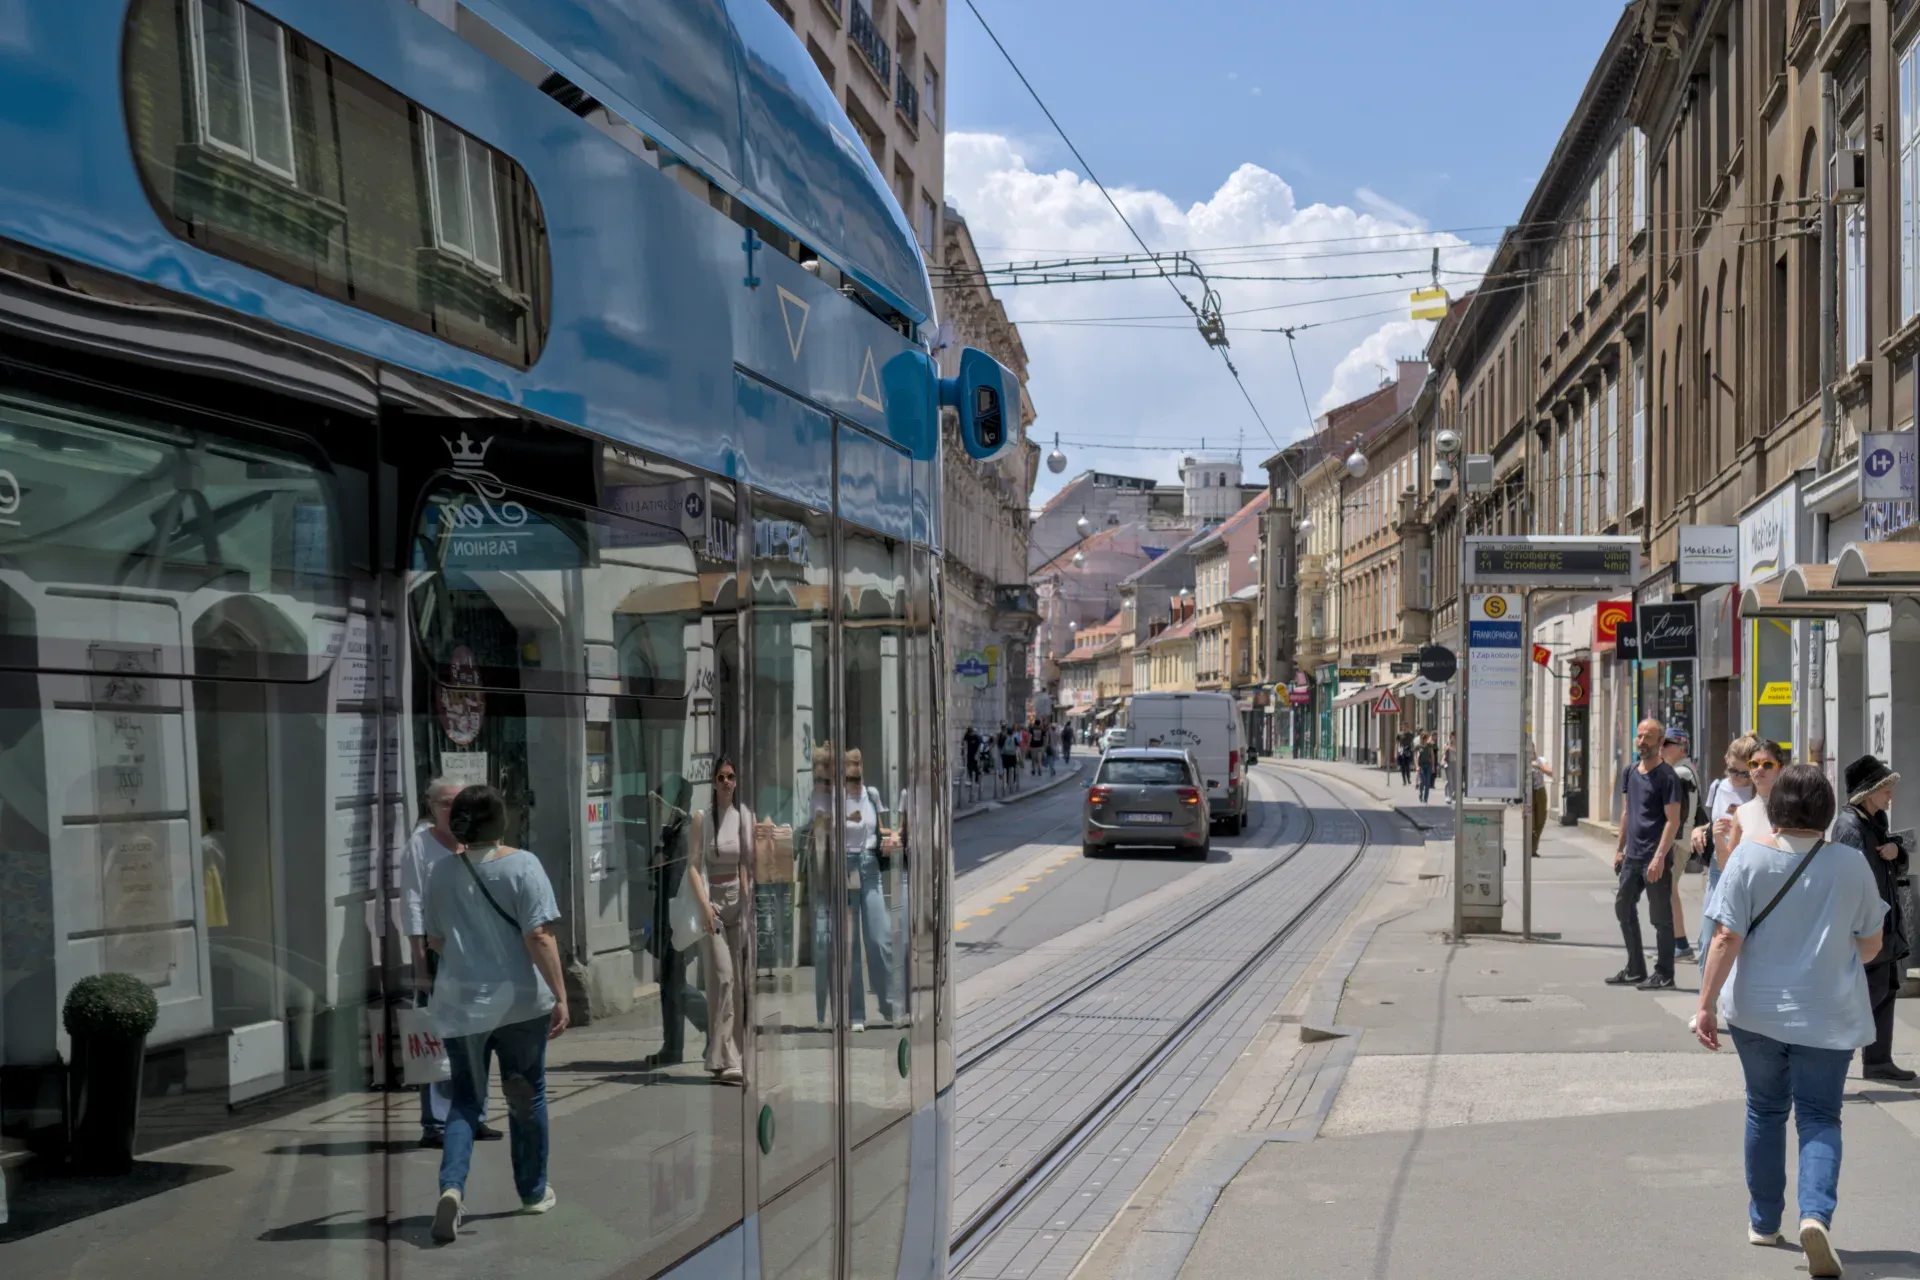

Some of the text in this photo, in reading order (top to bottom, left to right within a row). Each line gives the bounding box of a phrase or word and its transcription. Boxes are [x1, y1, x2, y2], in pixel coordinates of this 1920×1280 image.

[1604, 560, 1629, 570] 4min
[1490, 600, 1501, 614] S
[1644, 612, 1694, 645] Lena
[1472, 630, 1518, 640] FRANKOPANSKA
